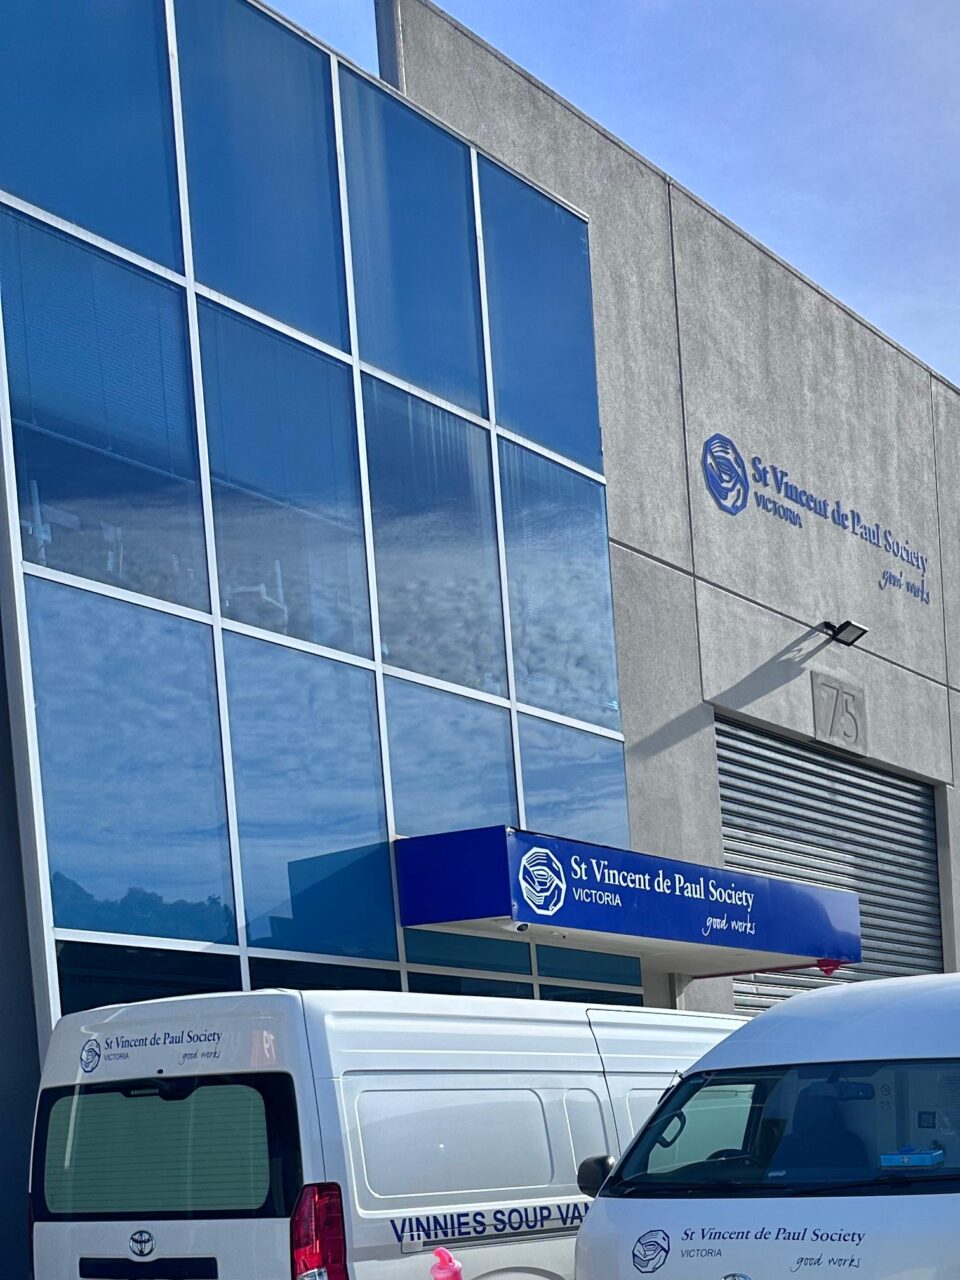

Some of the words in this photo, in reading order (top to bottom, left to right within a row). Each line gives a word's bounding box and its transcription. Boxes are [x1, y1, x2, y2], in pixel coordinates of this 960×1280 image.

[751, 456, 769, 488] St
[769, 465, 829, 519] Vincent
[831, 501, 849, 529] de
[849, 509, 881, 548] Paul
[884, 529, 928, 578] Society
[754, 491, 802, 528] VICTORIA
[878, 569, 904, 591] good
[820, 682, 859, 744] 75
[571, 855, 588, 880] St
[591, 859, 652, 891] Vincent
[654, 870, 672, 895] de
[675, 873, 706, 900] Paul
[708, 880, 755, 911] Society
[572, 887, 622, 907] VICTORIA
[702, 914, 728, 936] good
[731, 916, 756, 935] works
[104, 1038, 113, 1050] St
[115, 1036, 148, 1050] Vincent
[150, 1033, 162, 1046] de
[163, 1032, 184, 1045] Paul
[187, 1030, 223, 1045] Society
[104, 1053, 130, 1061] VICTORIA
[178, 1049, 199, 1065] good
[200, 1047, 222, 1060] works
[390, 1211, 487, 1243] VINNIES
[493, 1206, 552, 1232] SOUP
[681, 1228, 695, 1241] St
[700, 1227, 751, 1240] Vincent
[754, 1227, 771, 1240] de
[775, 1227, 807, 1242] Paul
[810, 1228, 866, 1246] Society
[680, 1249, 722, 1258] VICTORIA
[789, 1254, 823, 1273] good
[828, 1254, 861, 1269] works
